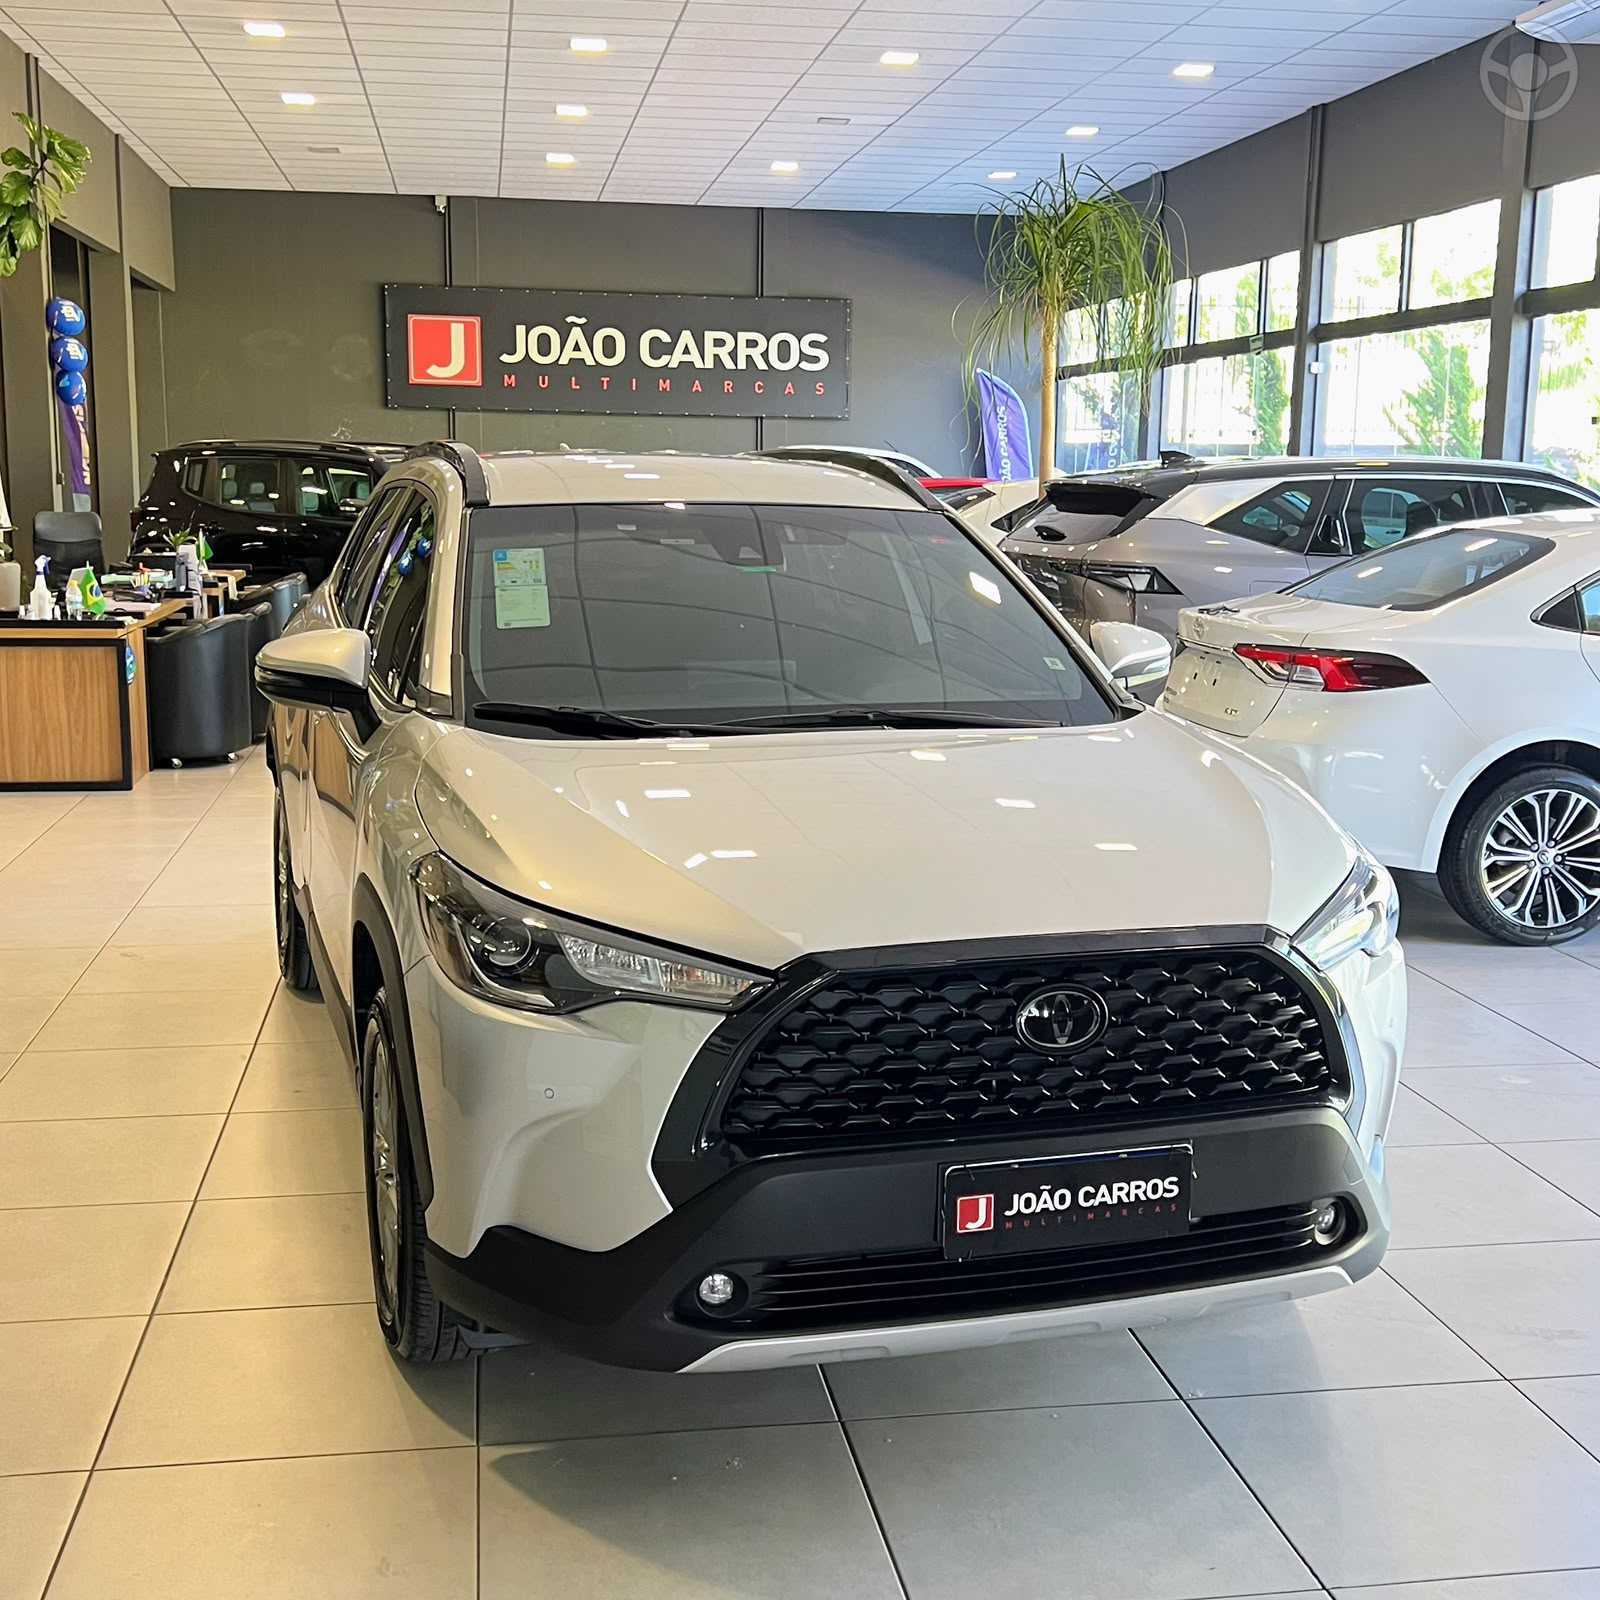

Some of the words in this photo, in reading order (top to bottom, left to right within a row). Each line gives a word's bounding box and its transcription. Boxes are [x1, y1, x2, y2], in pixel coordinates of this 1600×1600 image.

[426, 322, 465, 378] J
[499, 315, 626, 367] JOÃO
[639, 329, 829, 372] CARROS
[503, 374, 825, 396] MULTIMARCAS
[965, 1197, 987, 1230] J
[1004, 1185, 1072, 1216] JOÃO
[1077, 1176, 1180, 1208] CARROS
[1004, 1203, 1178, 1229] MULTIMARCAS
